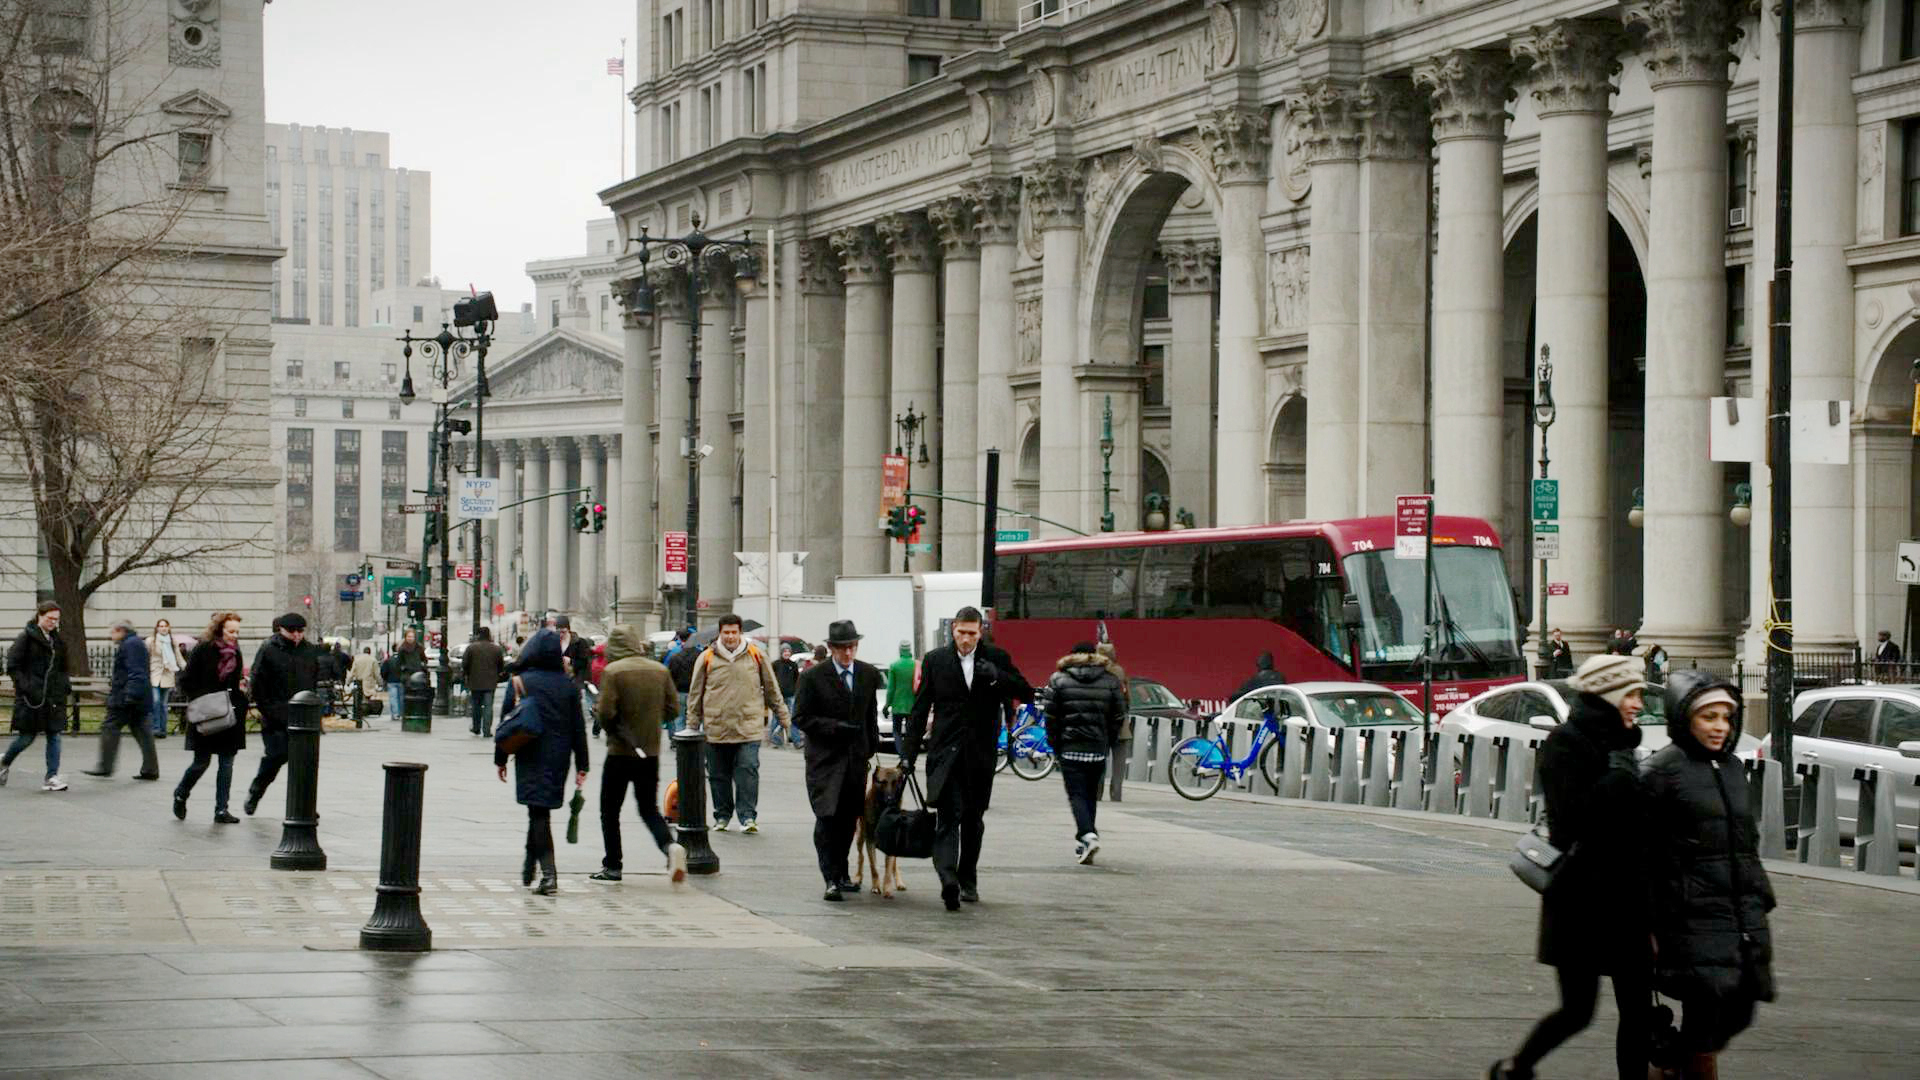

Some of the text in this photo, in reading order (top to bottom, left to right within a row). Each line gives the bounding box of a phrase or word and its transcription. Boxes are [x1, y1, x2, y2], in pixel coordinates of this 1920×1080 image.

[1099, 37, 1202, 102] MANHATTAN
[840, 141, 921, 192] AMSTERDAM
[465, 480, 492, 489] NYPD
[1351, 539, 1375, 552] 704
[1473, 535, 1493, 547] 704
[1318, 562, 1331, 574] 704
